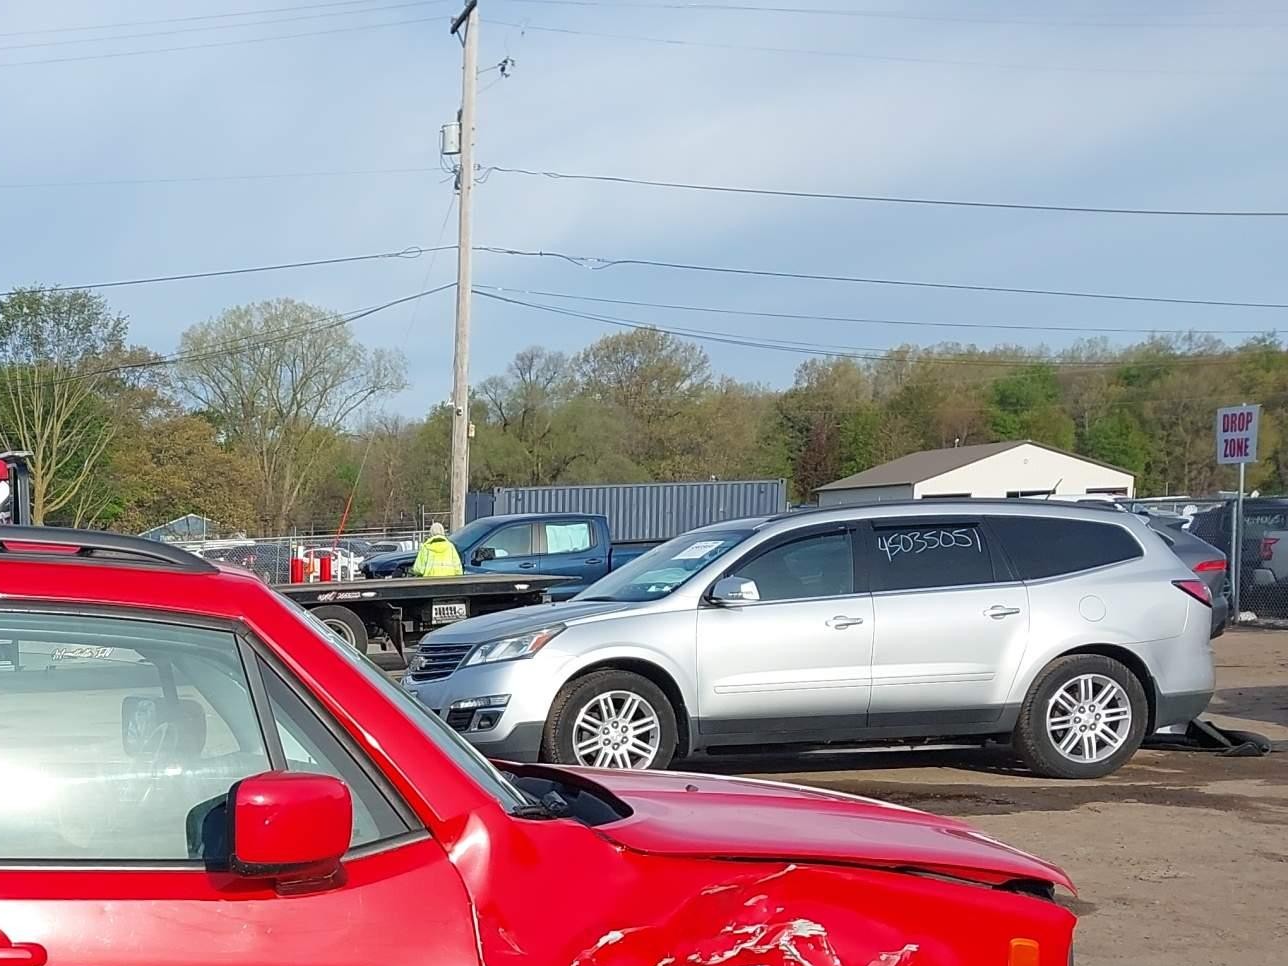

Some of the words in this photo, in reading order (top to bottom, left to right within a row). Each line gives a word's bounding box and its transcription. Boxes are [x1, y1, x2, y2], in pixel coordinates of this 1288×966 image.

[1222, 411, 1253, 433] DROP
[1223, 437, 1251, 458] ZONE
[877, 528, 982, 563] 45035051
